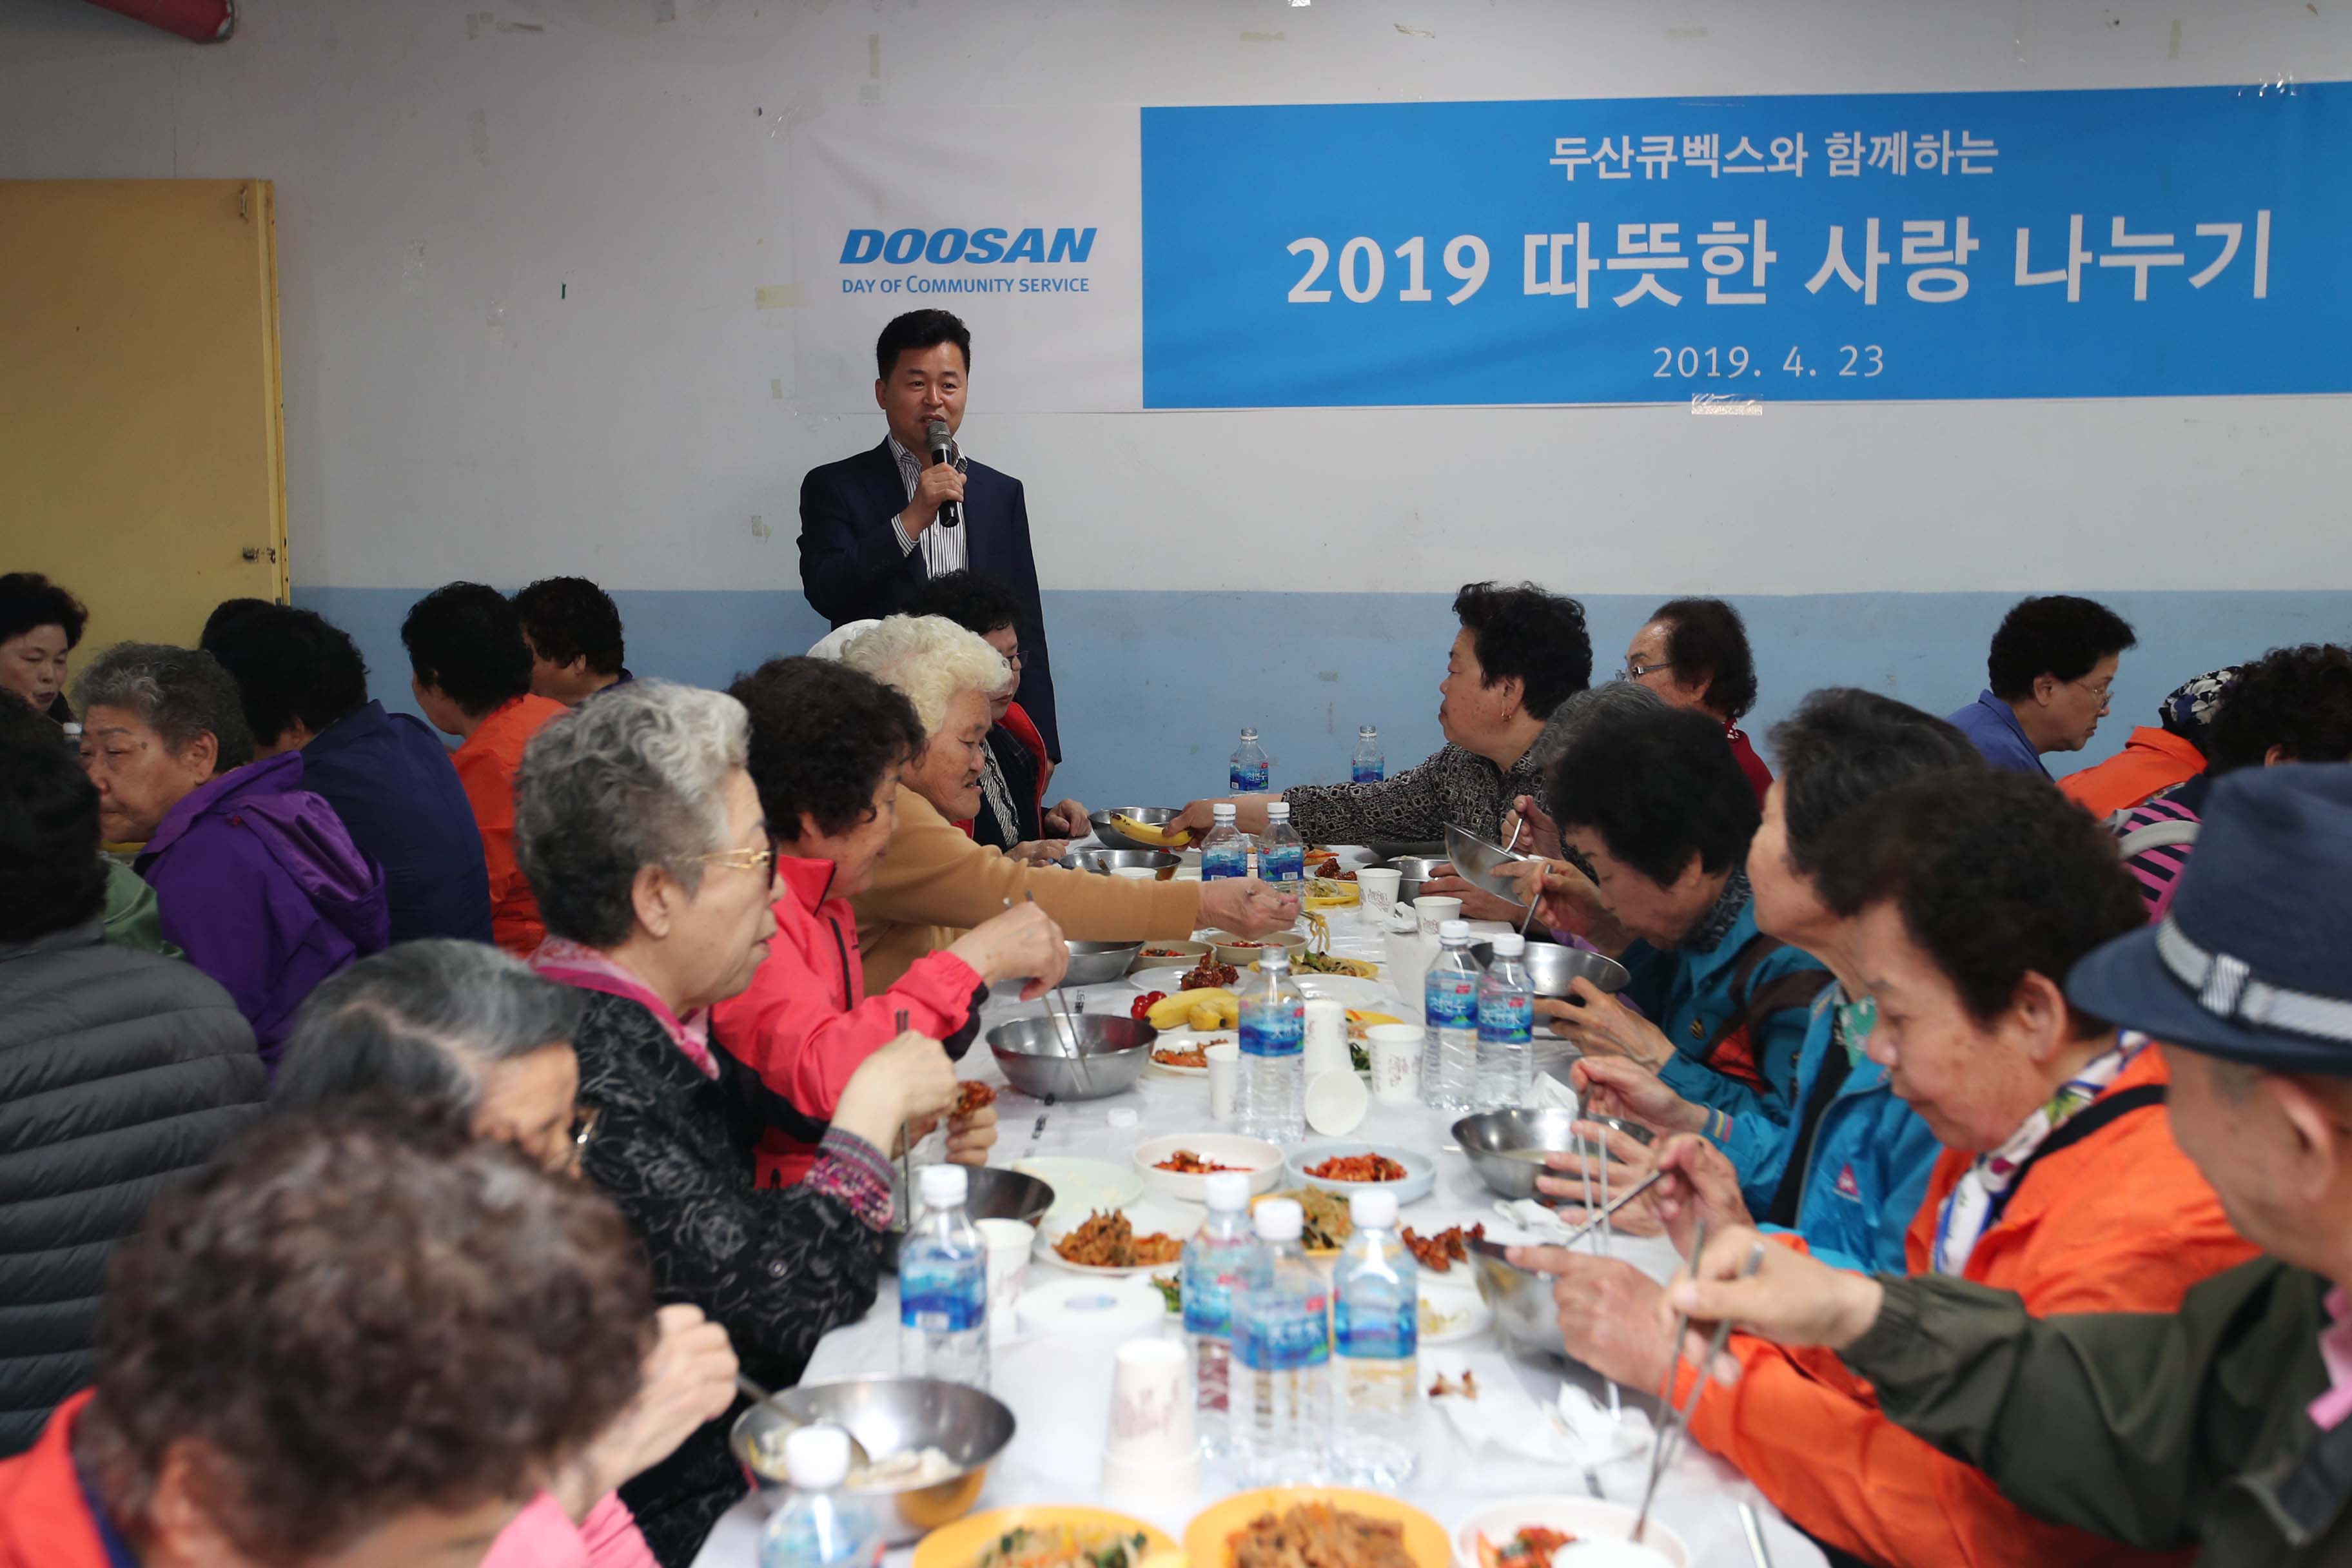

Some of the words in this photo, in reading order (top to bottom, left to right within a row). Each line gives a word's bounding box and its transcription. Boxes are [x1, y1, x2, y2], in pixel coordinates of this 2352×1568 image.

[1549, 132, 1808, 181] 두산큐벡스와
[1825, 130, 1999, 177] 함께하는
[838, 226, 1097, 265] DOOSAN
[1286, 234, 1490, 306] 2019
[1524, 219, 1777, 309] 따뜻한
[1805, 216, 1979, 306] 사랑
[2015, 210, 2271, 302] 나누기
[842, 279, 876, 293] DAY
[880, 279, 901, 293] OF
[905, 275, 1015, 293] COMMUNITY
[1019, 278, 1089, 293] SERVICE
[1653, 346, 1761, 378] 2019.
[1783, 346, 1816, 377] 4.
[1839, 345, 1883, 377] 23
